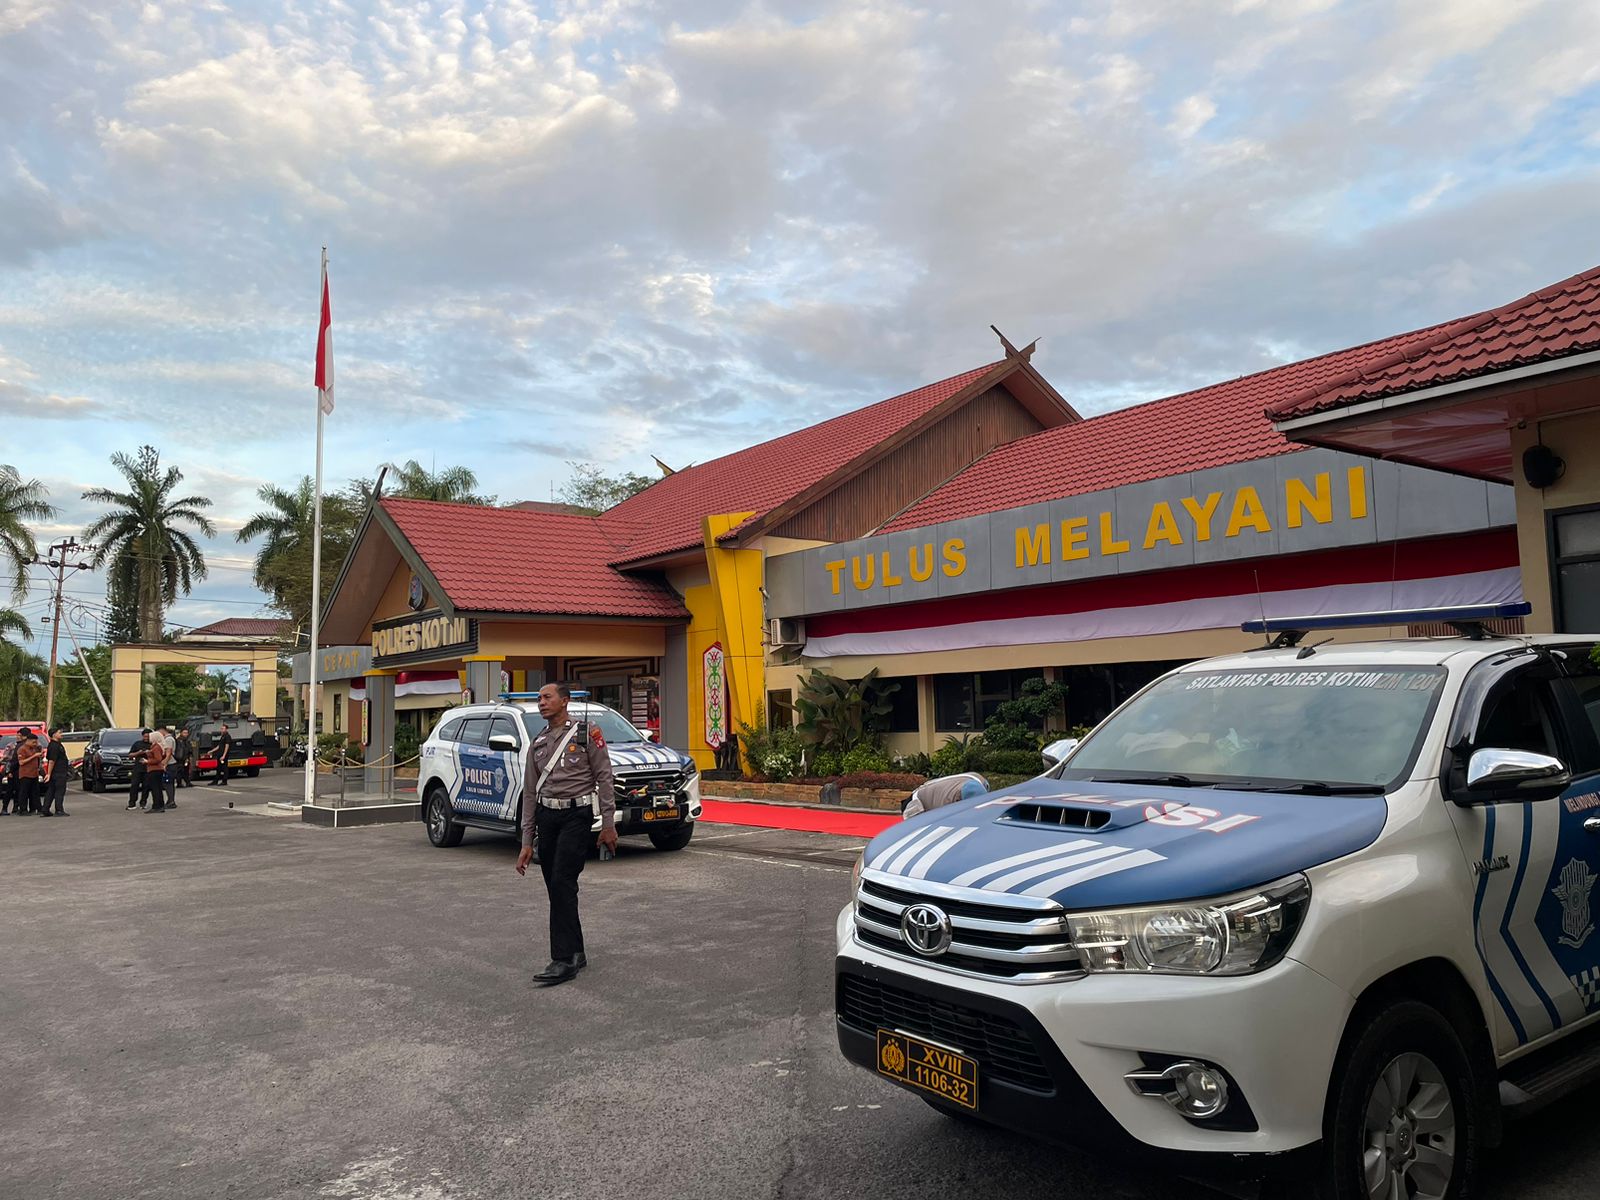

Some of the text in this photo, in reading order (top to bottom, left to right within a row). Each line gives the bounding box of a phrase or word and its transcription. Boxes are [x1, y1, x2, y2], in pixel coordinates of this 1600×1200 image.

[825, 466, 1368, 595] TULUS MELAYANI
[372, 623, 422, 658] POLRES
[1185, 673, 1268, 690] SATLANTAS
[1262, 671, 1328, 687] POLRES
[1323, 672, 1385, 688] KOTIM
[465, 768, 492, 786] POLISI
[923, 1046, 962, 1075] XVIII
[915, 1065, 969, 1102] 1106-32
